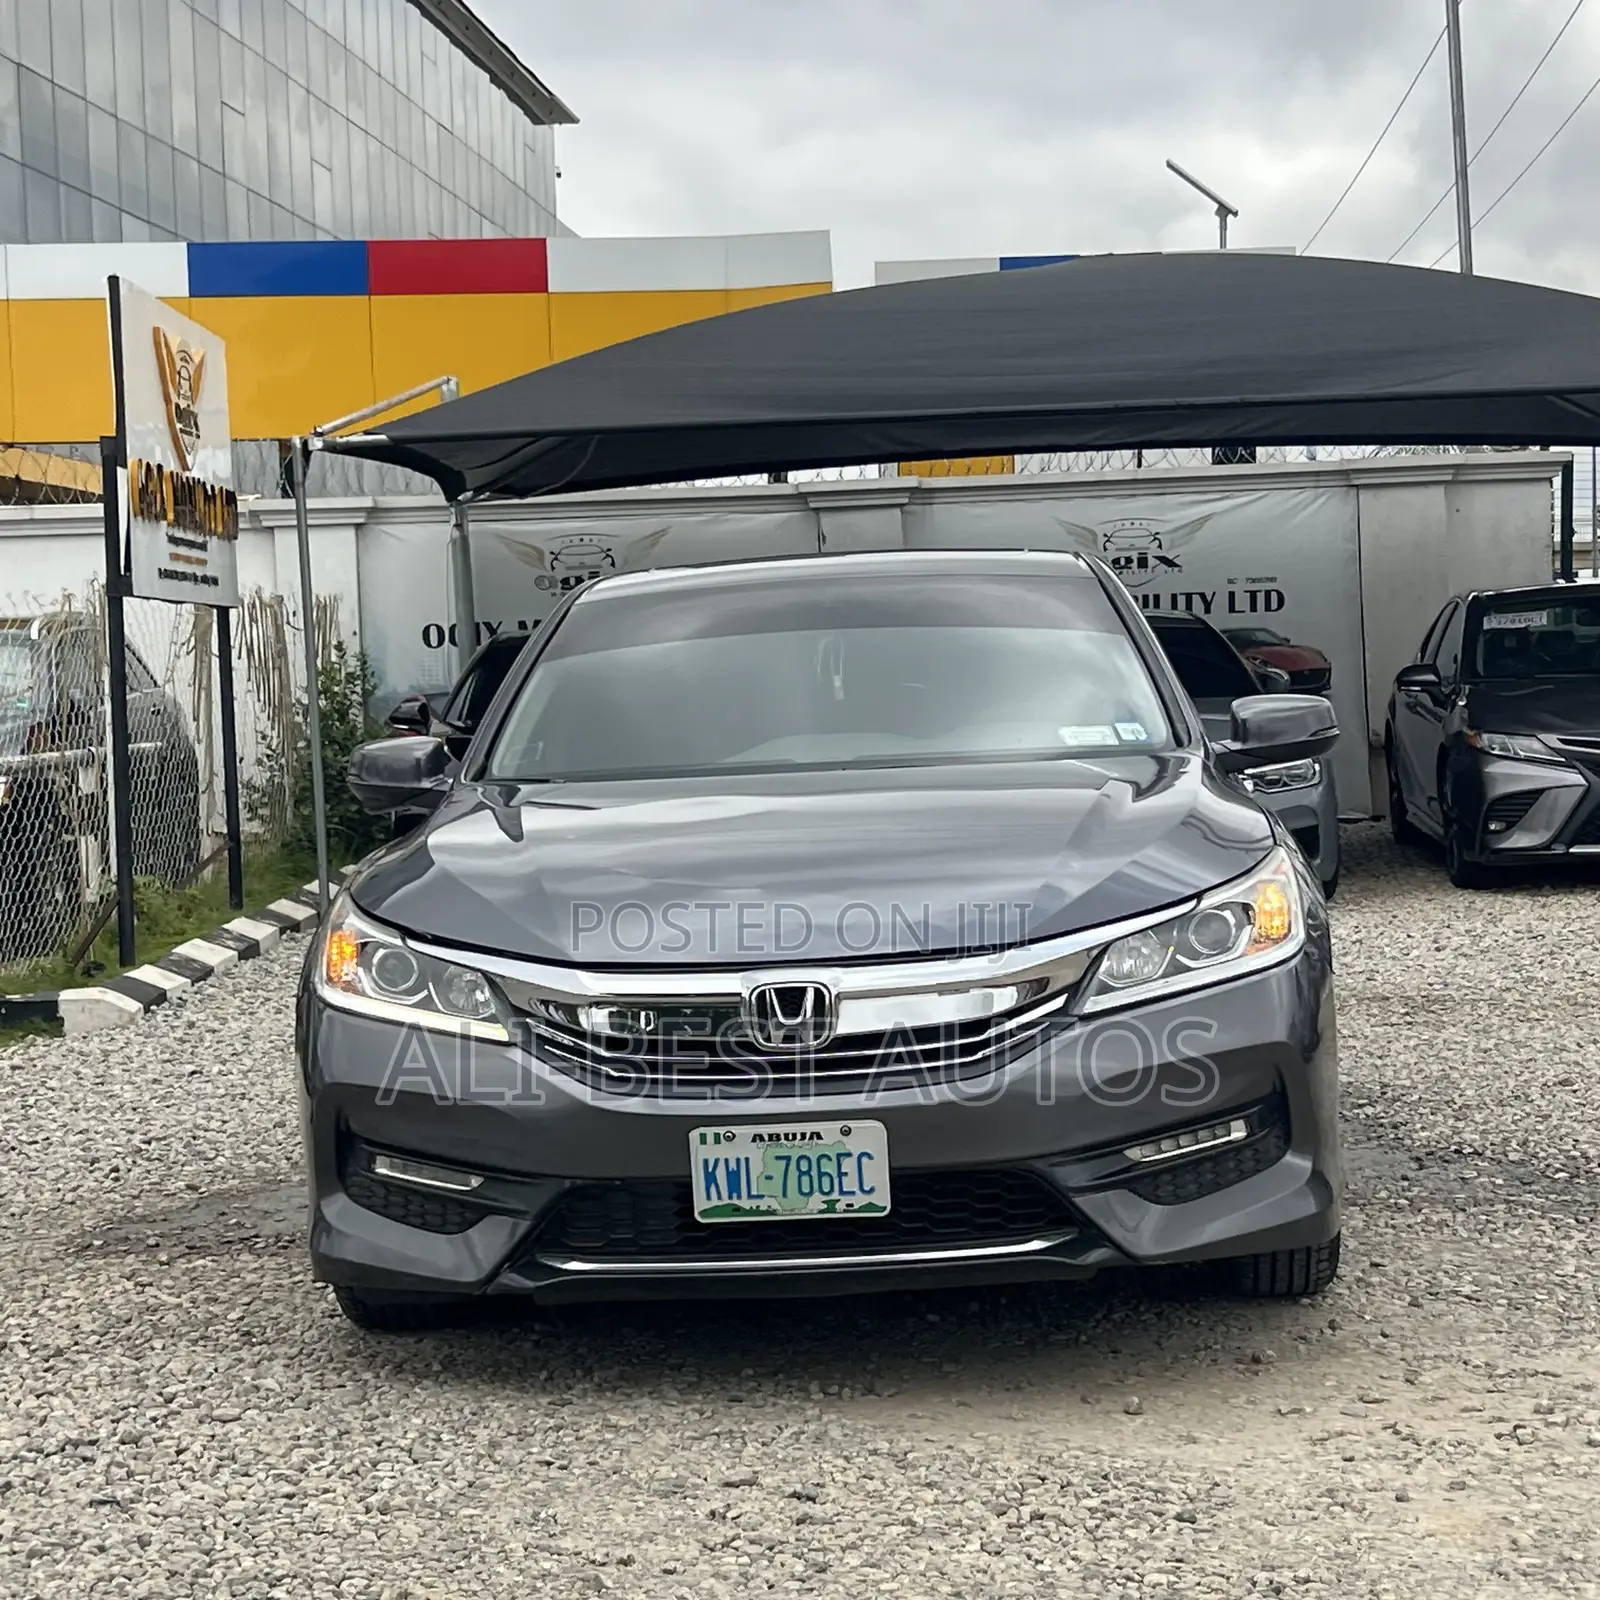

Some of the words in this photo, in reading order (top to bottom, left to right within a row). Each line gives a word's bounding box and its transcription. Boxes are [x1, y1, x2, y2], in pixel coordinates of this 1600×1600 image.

[1104, 552, 1182, 570] gix
[1228, 588, 1285, 614] LTD
[750, 1131, 824, 1143] ABUJA
[702, 1151, 876, 1201] KWL-786EC
